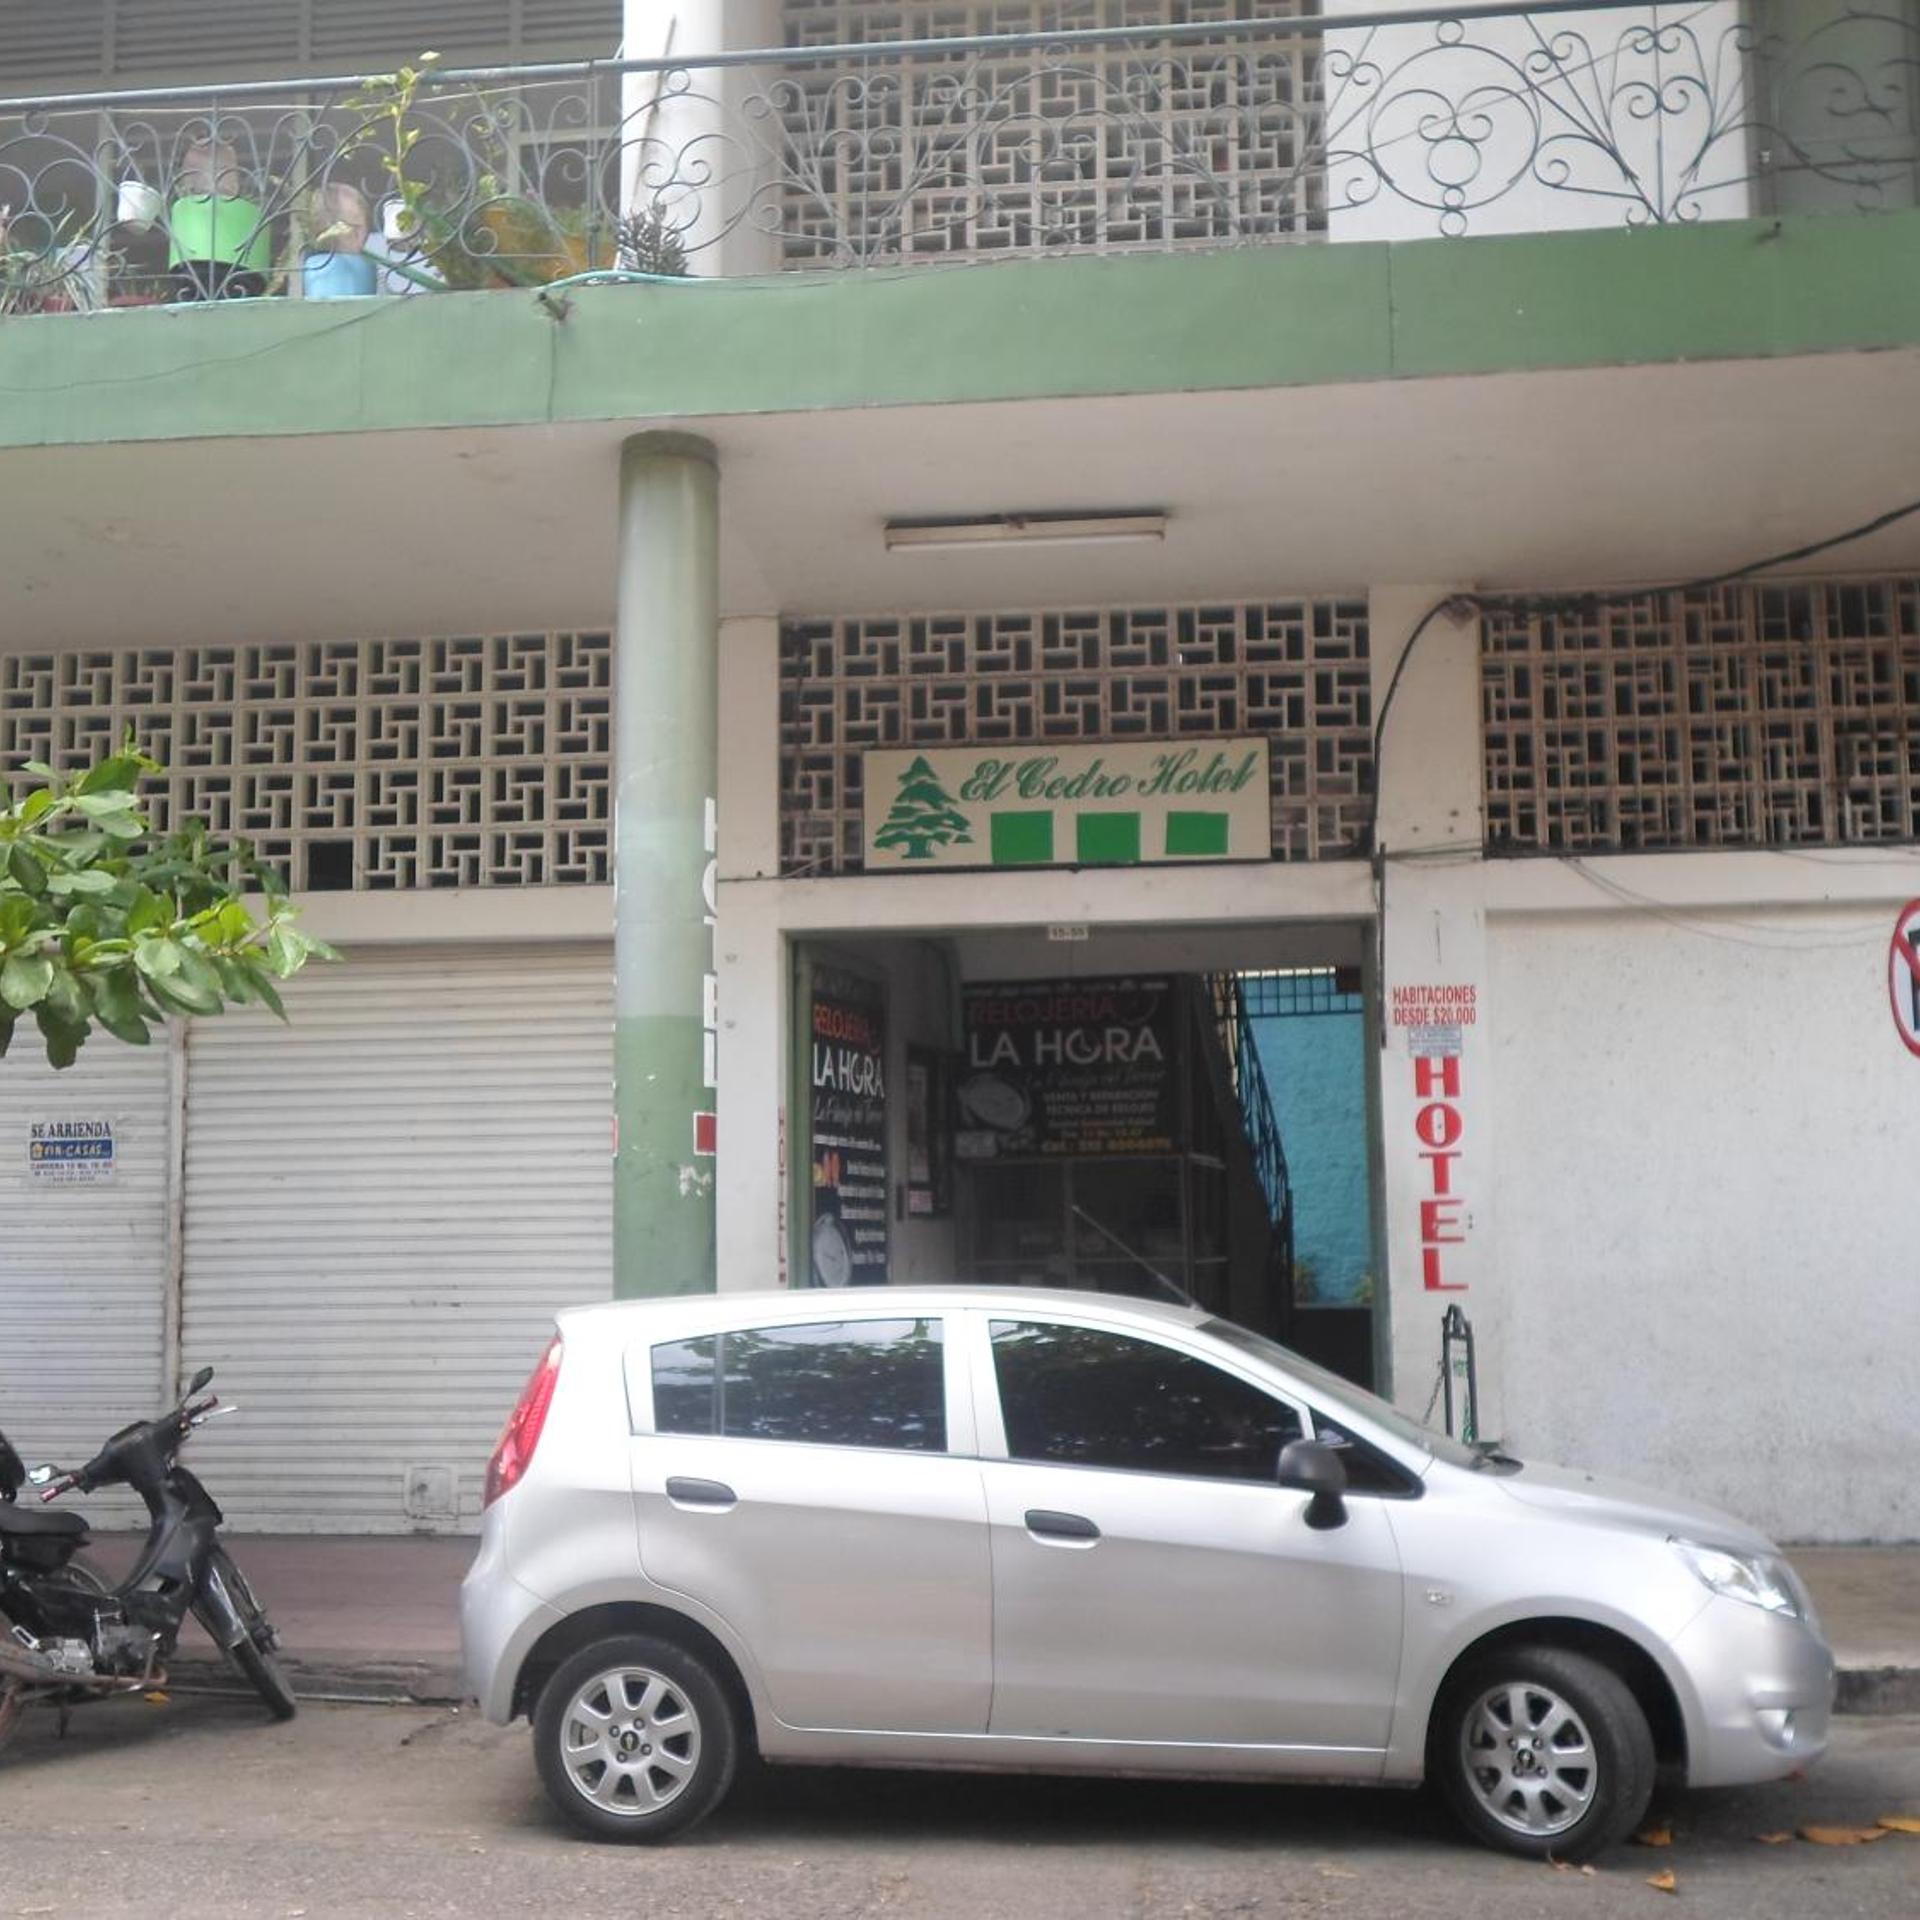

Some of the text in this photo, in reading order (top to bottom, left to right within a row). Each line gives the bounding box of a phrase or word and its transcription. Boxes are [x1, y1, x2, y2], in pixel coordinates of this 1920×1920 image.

[960, 748, 1259, 801] El Cedro Hotel
[1392, 985, 1477, 1005] HABITACIONES
[1394, 1007, 1430, 1027] DESDE
[970, 1026, 1164, 1068] LA HORA
[813, 1042, 886, 1099] LA HORA
[31, 1121, 111, 1138] SE ARRIENDA
[1415, 1056, 1469, 1290] HOTEL
